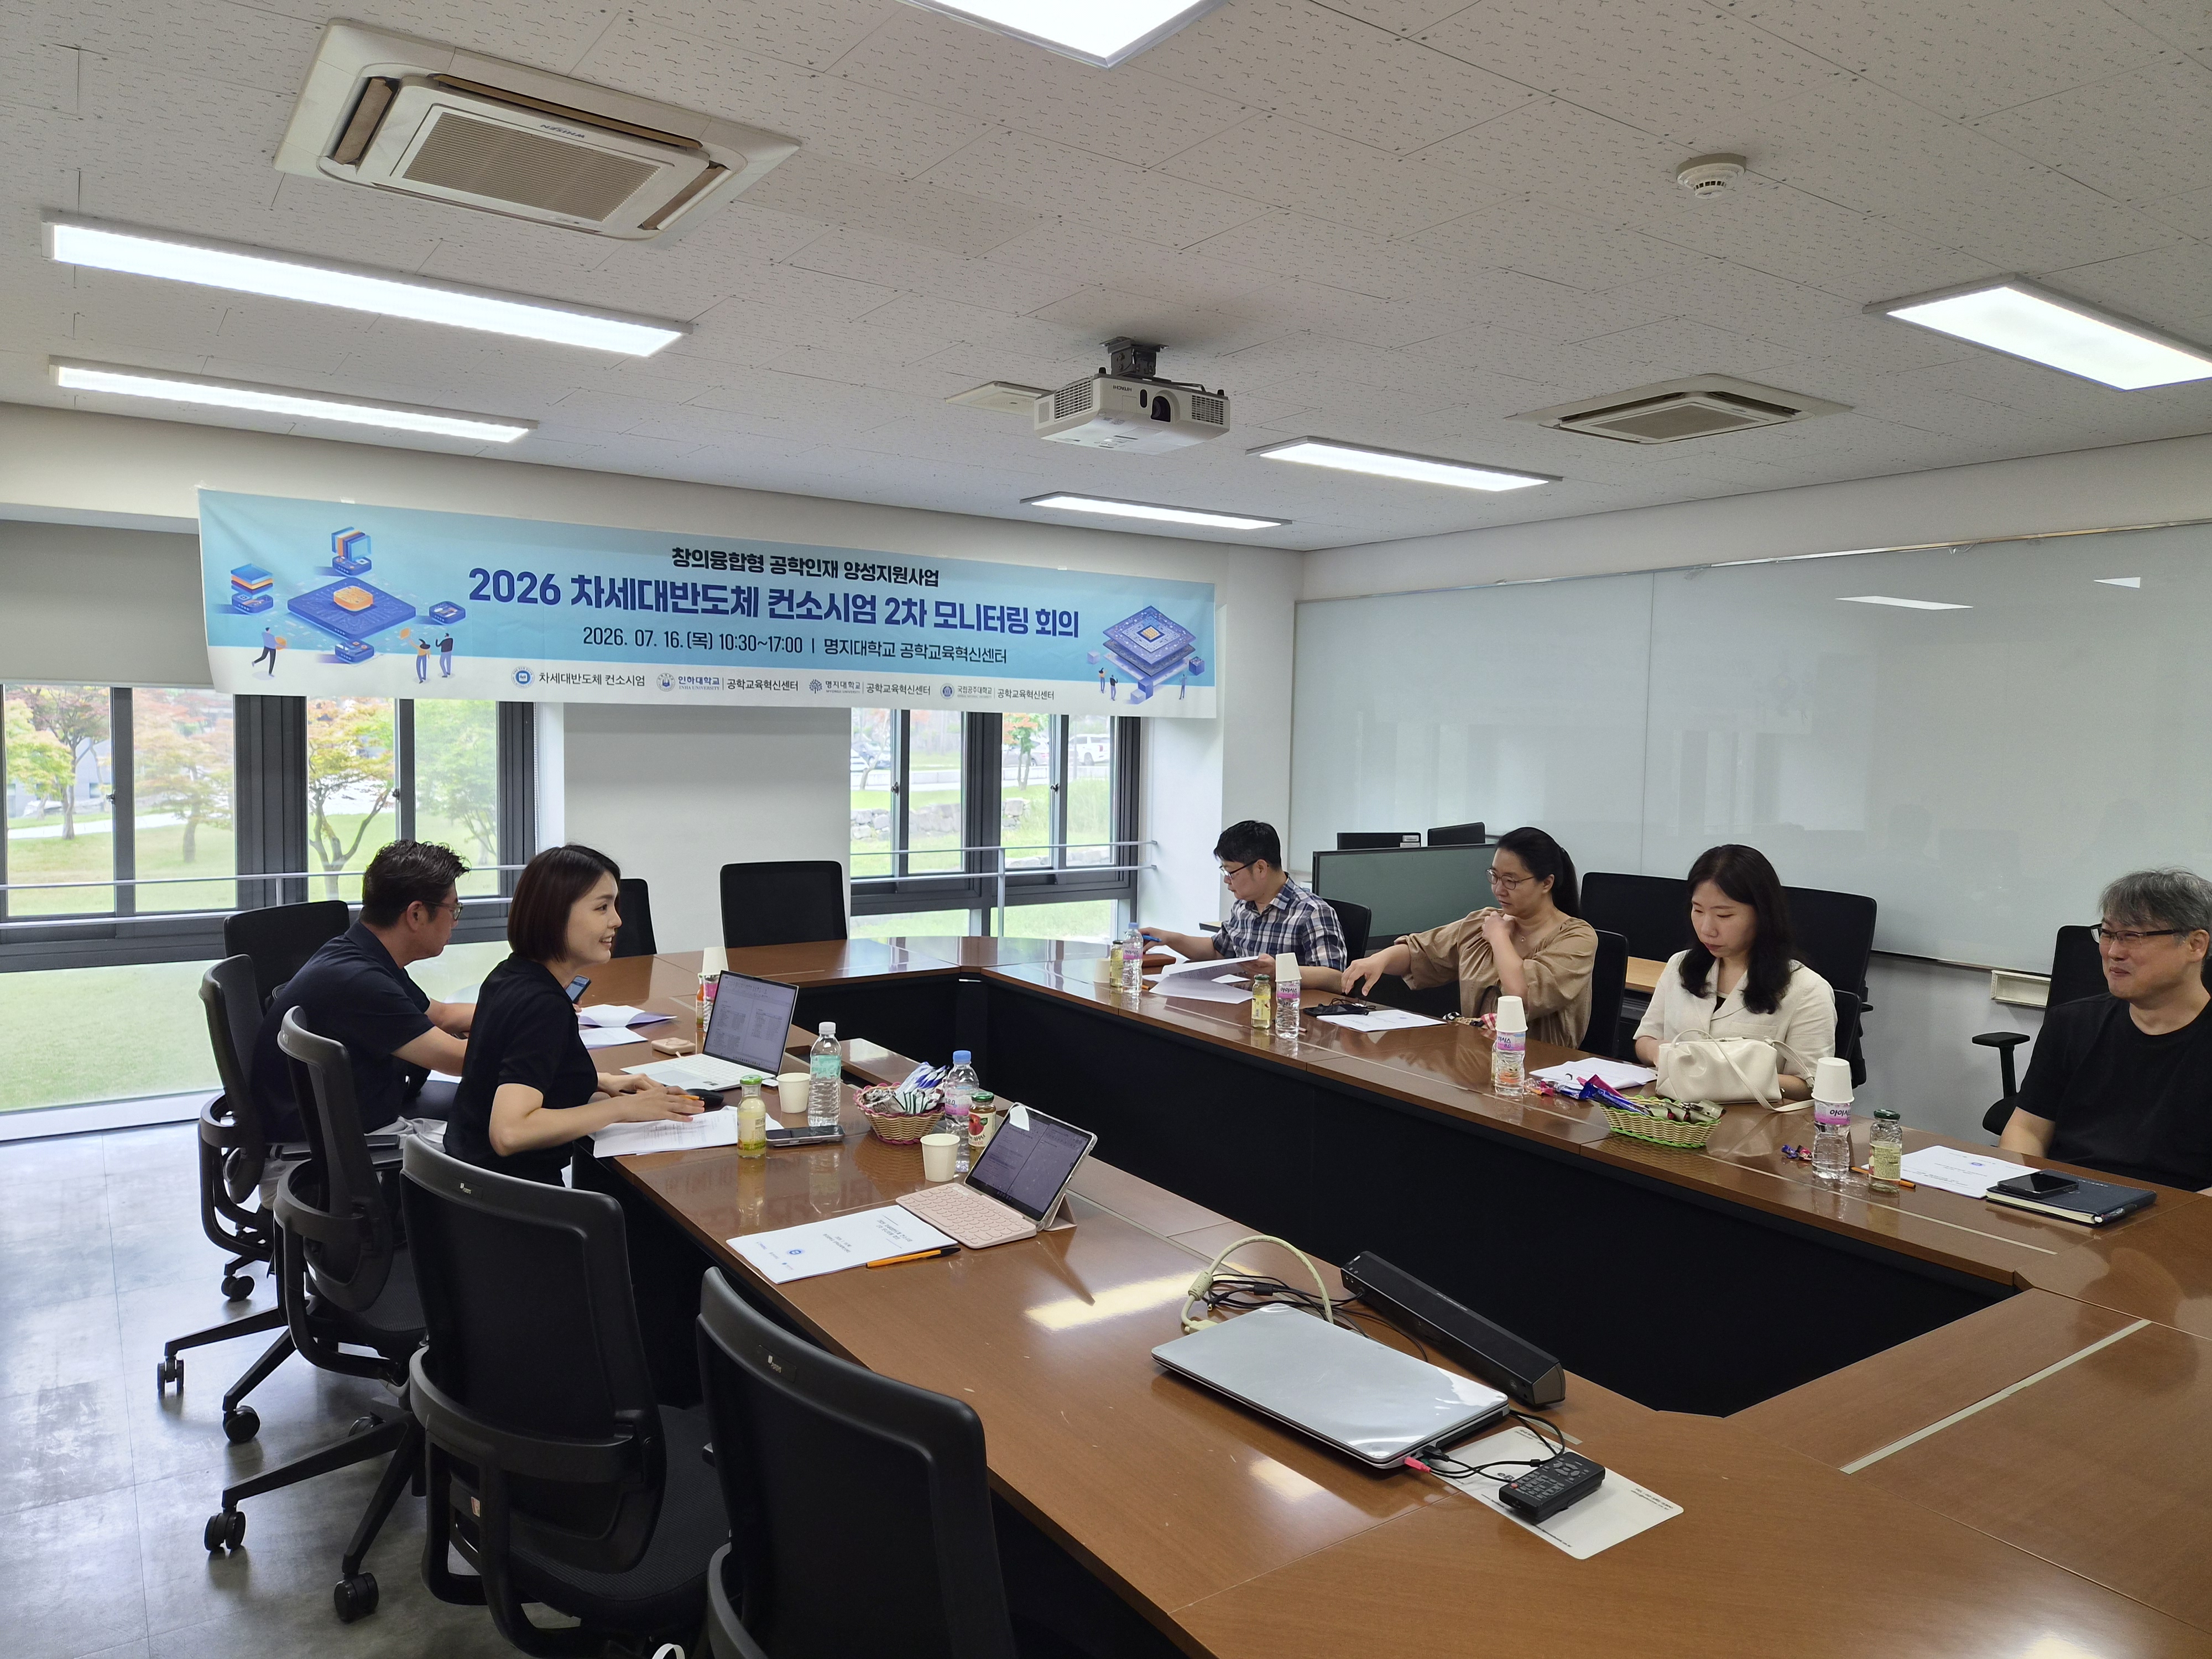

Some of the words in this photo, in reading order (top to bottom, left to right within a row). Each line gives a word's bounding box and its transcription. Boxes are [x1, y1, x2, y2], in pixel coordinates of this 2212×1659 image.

[540, 124, 585, 138] WHISEN
[672, 547, 764, 573] 창의융합형
[769, 555, 838, 579] 공학인재
[843, 561, 939, 588] 양성지원사업
[469, 567, 561, 606] 2026
[571, 574, 759, 618] 차세대반도체
[768, 588, 877, 625] 컨소시엄
[884, 597, 927, 628] 2차
[933, 601, 1029, 635] 모니터링
[1035, 608, 1079, 638] 회의
[583, 627, 628, 646] 2026.
[635, 629, 658, 648] 07.
[719, 633, 803, 654] 10:30~17:00
[824, 638, 896, 658] 명지대학교
[900, 643, 1008, 665] 공학교육혁신센터
[539, 672, 602, 686] 차세대반도체
[605, 674, 645, 686] 컨소시엄
[678, 676, 720, 686] 인하대학교
[727, 679, 799, 692] 공학교육혁신센터
[825, 680, 860, 690] 명지대학교
[866, 683, 931, 696] 공학교육혁신센터
[957, 685, 992, 695] 국립공주대학교
[997, 688, 1055, 700] 공학교육혁신센터
[973, 1133, 986, 1141] APPLE
